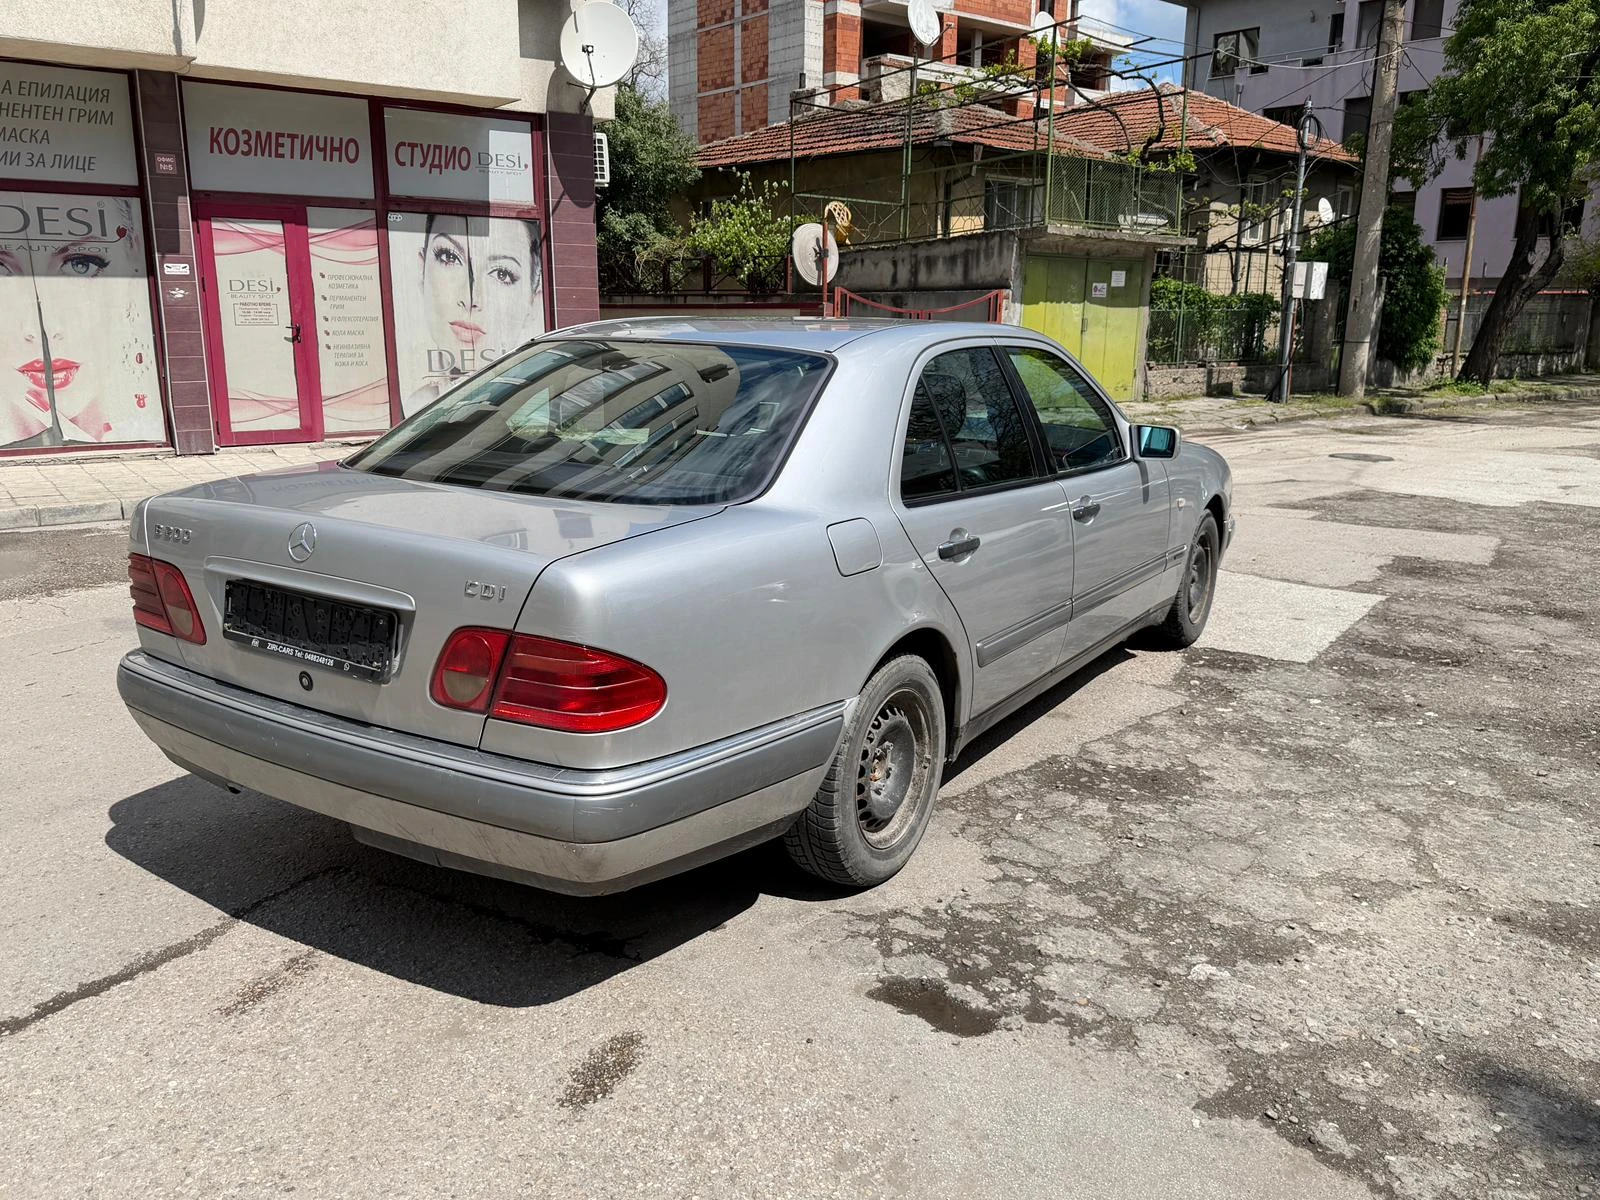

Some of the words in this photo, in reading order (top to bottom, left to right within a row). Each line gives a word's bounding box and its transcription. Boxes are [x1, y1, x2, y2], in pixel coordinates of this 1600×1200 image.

[17, 80, 110, 105] ЕПИЛАЦИЯ
[69, 107, 114, 126] ГРИМ
[209, 126, 360, 164] КОЗМЕТИЧНО
[24, 151, 46, 168] ЗА
[50, 153, 97, 173] ЛИЦЕ
[394, 141, 471, 175] СТУДИО
